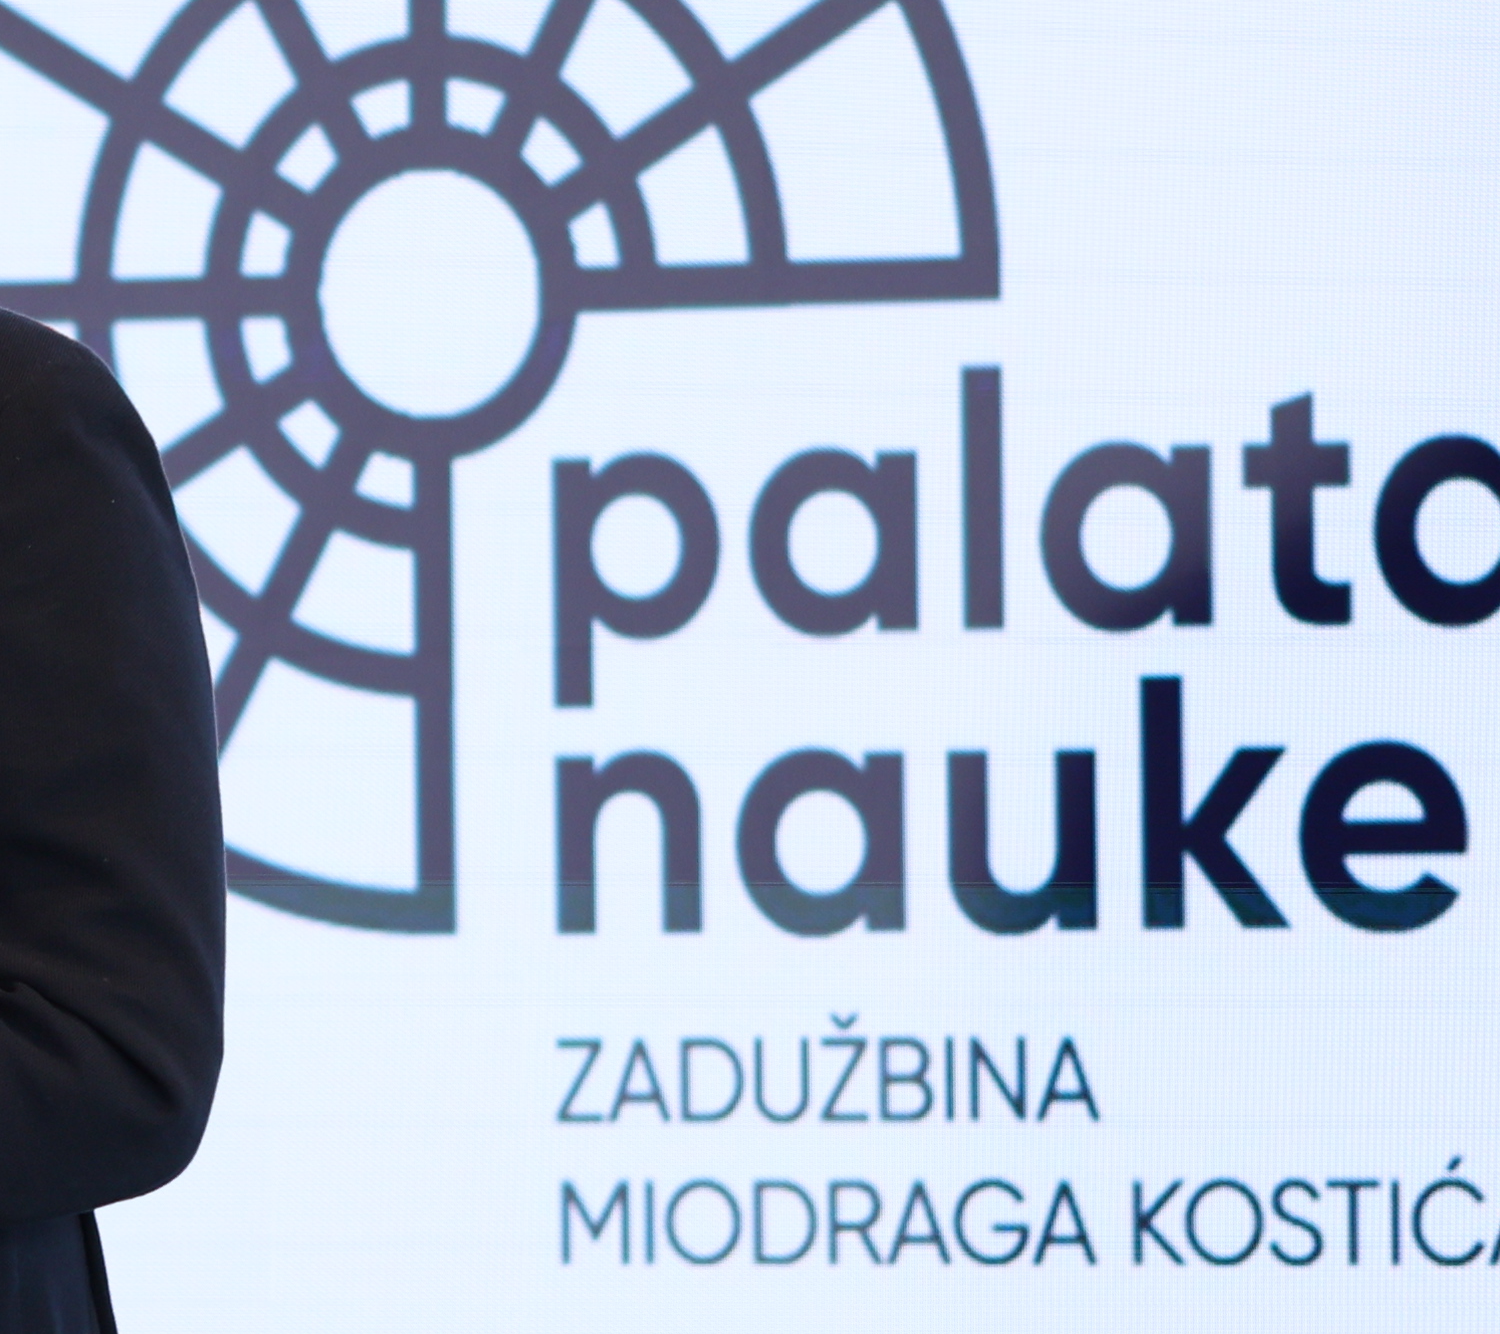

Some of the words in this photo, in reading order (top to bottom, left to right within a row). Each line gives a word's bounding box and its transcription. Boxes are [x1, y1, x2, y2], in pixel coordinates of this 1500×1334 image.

[553, 673, 1472, 939] nauke
[556, 1015, 1102, 1124] ZADUŽBINA
[560, 1177, 1099, 1267] MIODRAGA
